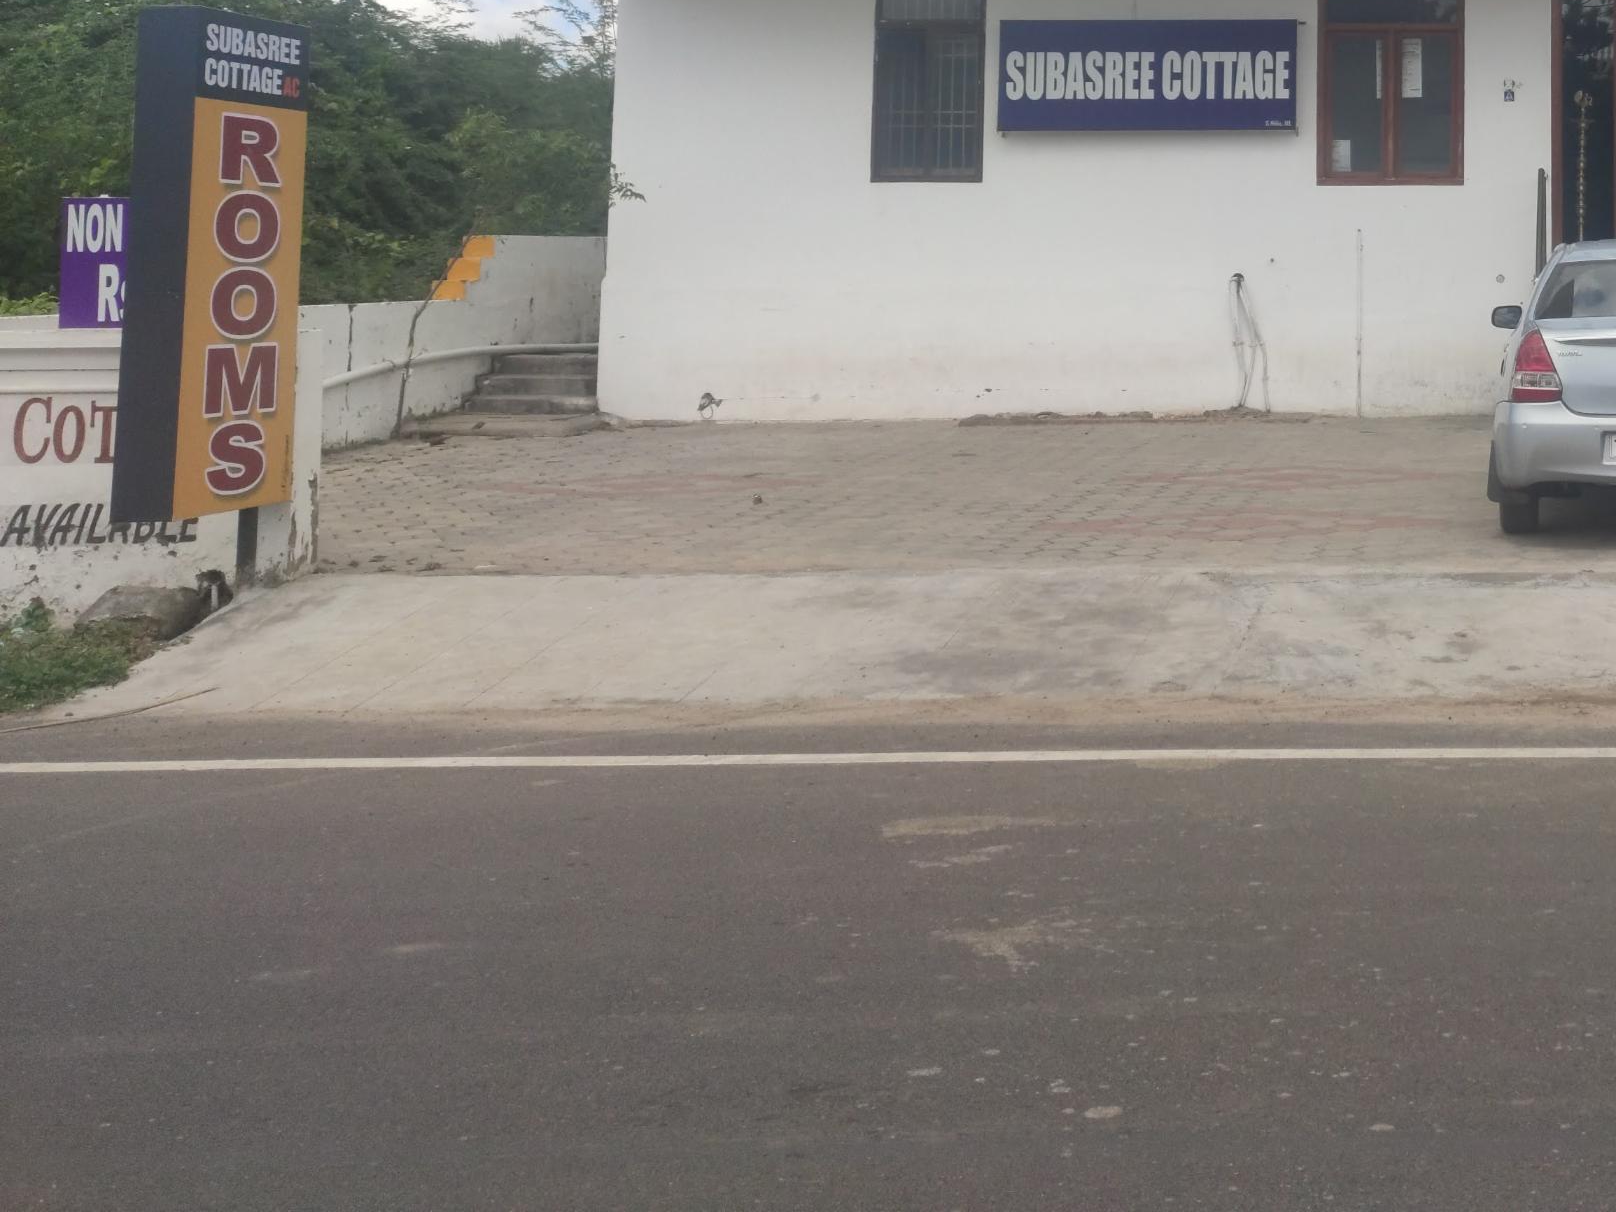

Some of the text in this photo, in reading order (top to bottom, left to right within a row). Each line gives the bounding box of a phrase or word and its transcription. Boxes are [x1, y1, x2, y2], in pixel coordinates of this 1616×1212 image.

[205, 23, 301, 65] SUBASREE
[204, 57, 283, 95] COTTAGE
[283, 76, 301, 99] AC
[1005, 50, 1290, 100] SUBASREE COTTAGE
[66, 203, 124, 253] NON
[97, 263, 126, 322] R
[202, 111, 283, 496] ROOMS
